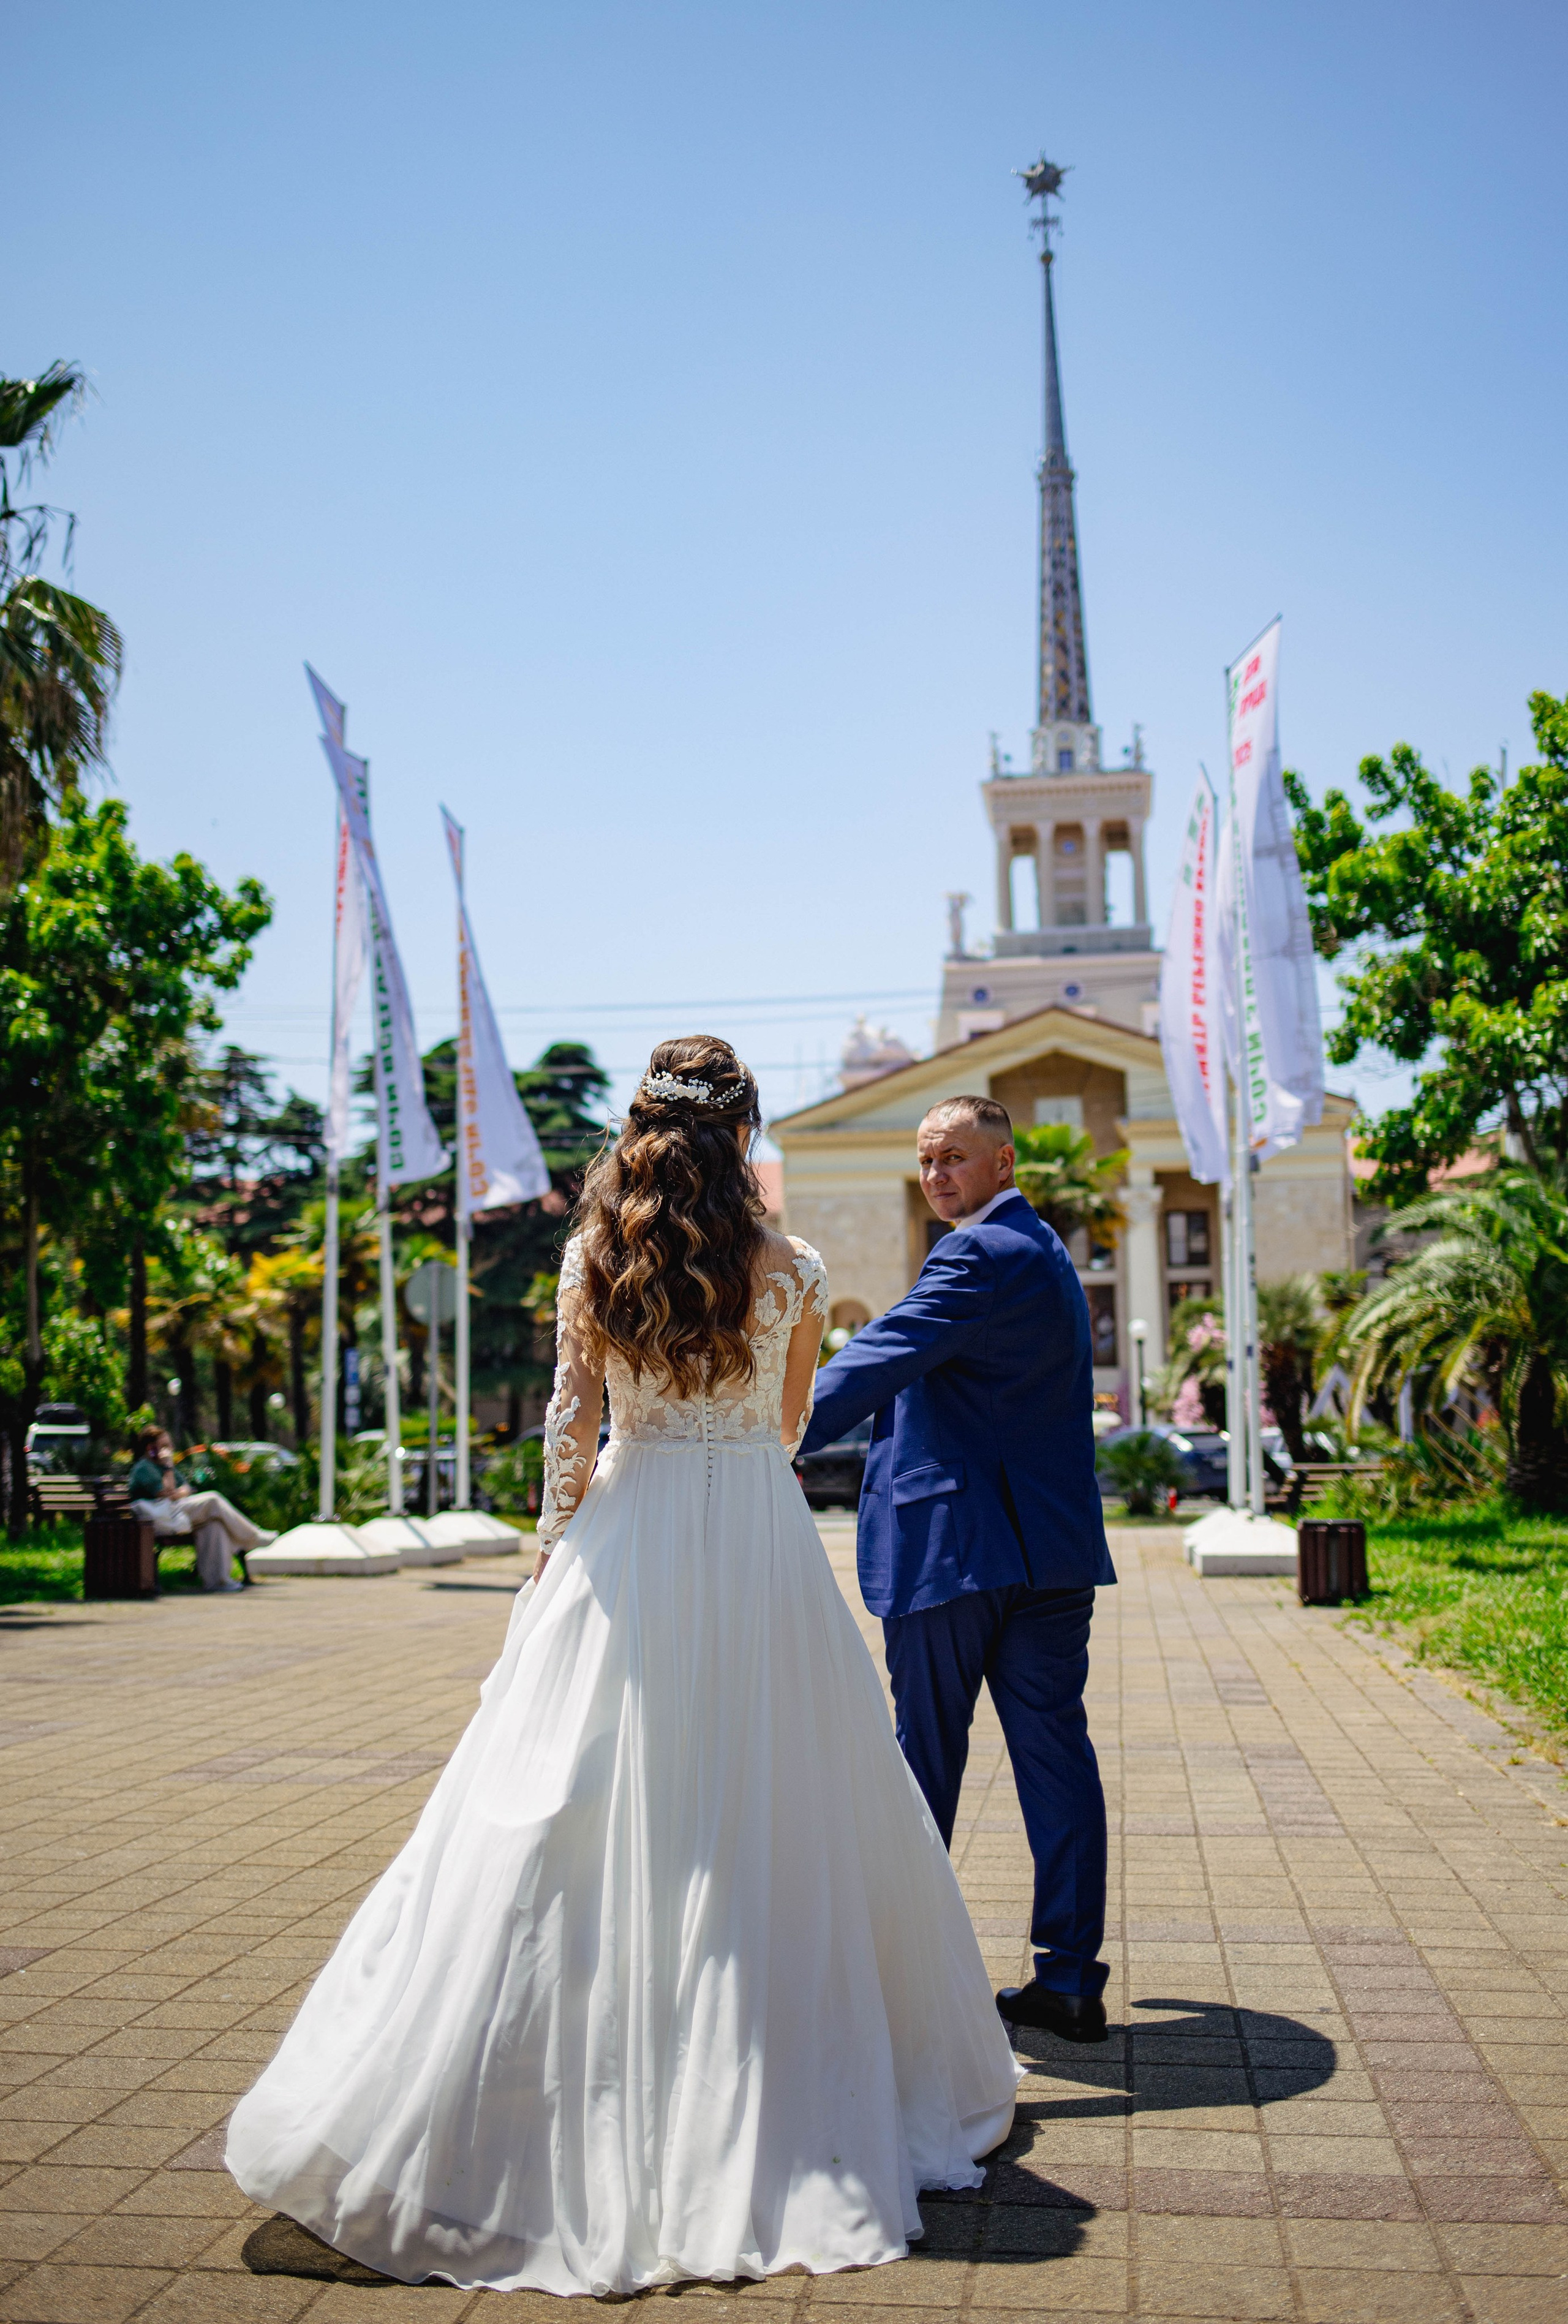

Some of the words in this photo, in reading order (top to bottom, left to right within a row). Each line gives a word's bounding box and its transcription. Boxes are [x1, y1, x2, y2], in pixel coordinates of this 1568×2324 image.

[1248, 1032, 1267, 1123] СОЧИ
[387, 1084, 404, 1169] СОЧИ
[467, 1123, 489, 1198] СОЧИ
